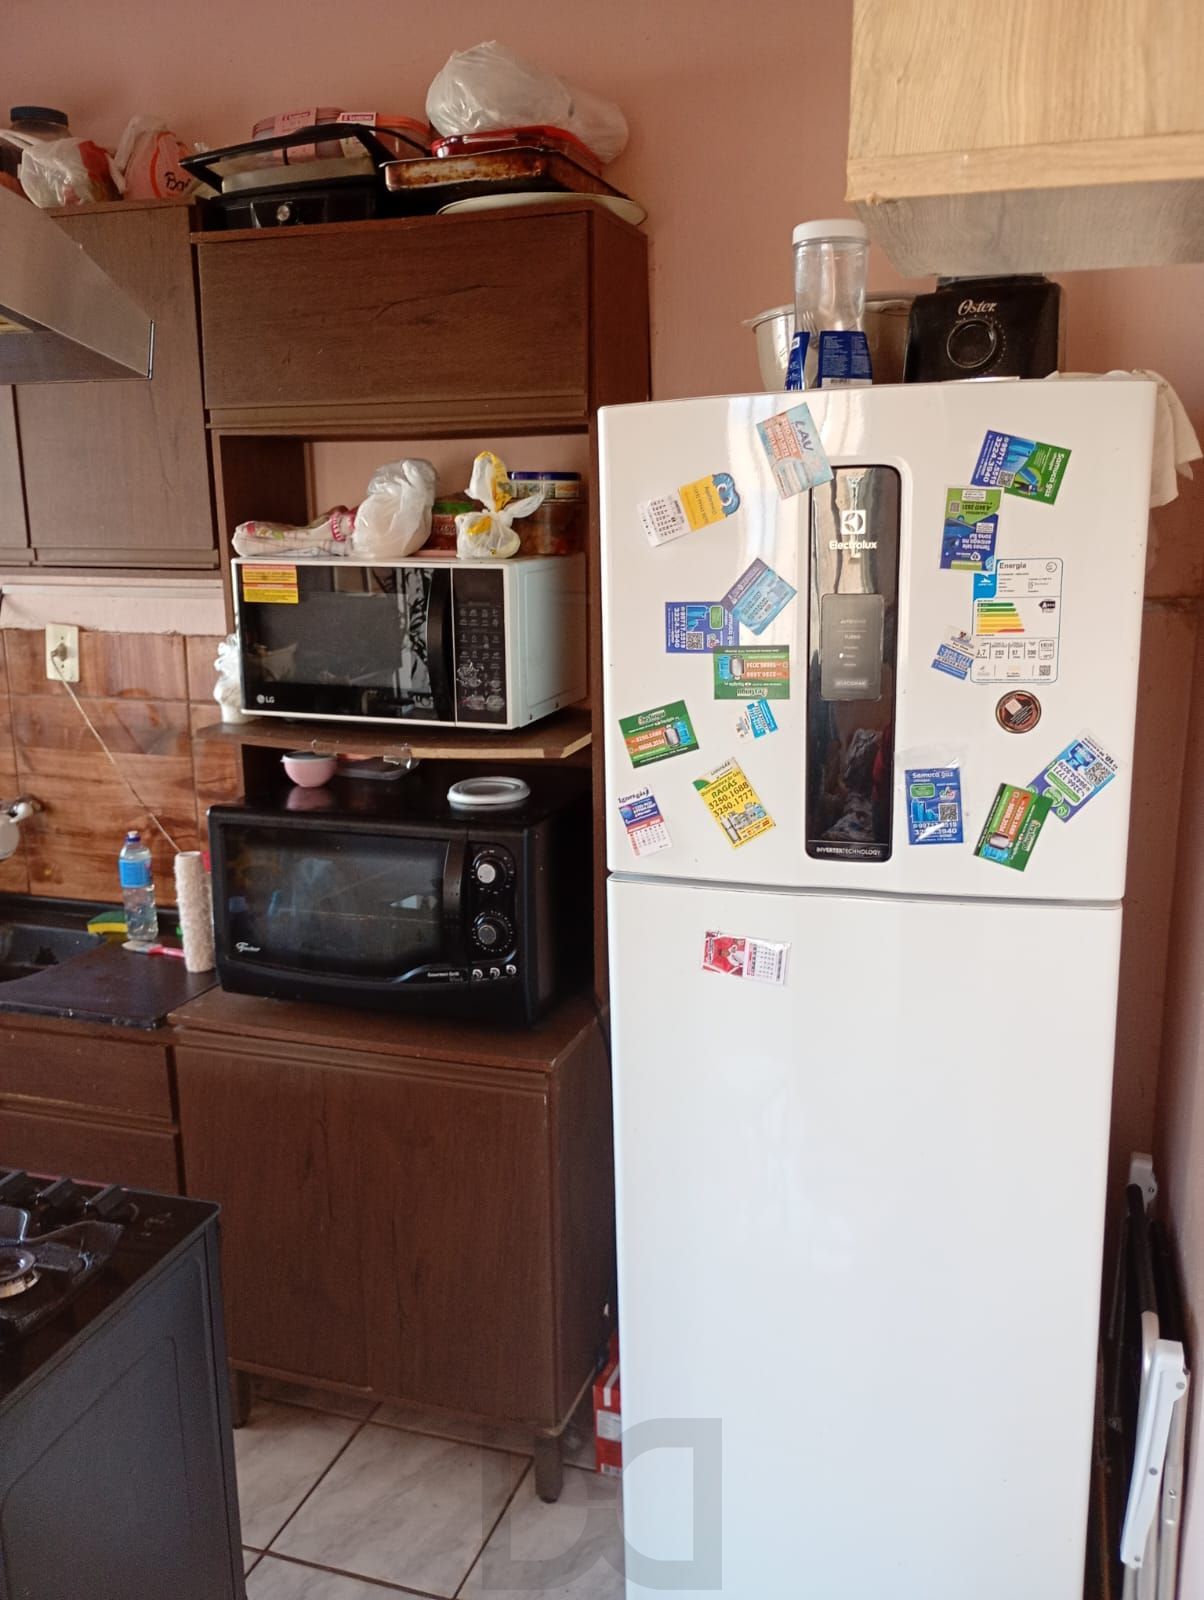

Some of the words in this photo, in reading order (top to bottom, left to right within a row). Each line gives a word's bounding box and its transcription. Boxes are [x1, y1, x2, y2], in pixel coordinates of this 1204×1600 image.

[958, 299, 998, 316] Oster
[1048, 452, 1064, 482] Samuca
[829, 540, 877, 550] Electrolux
[1000, 562, 1026, 570] Energia
[710, 778, 737, 798] RAGÁS
[1052, 766, 1082, 793] 3266.1771
[707, 781, 749, 809] 3250.1688
[712, 788, 754, 817] 3250.1777
